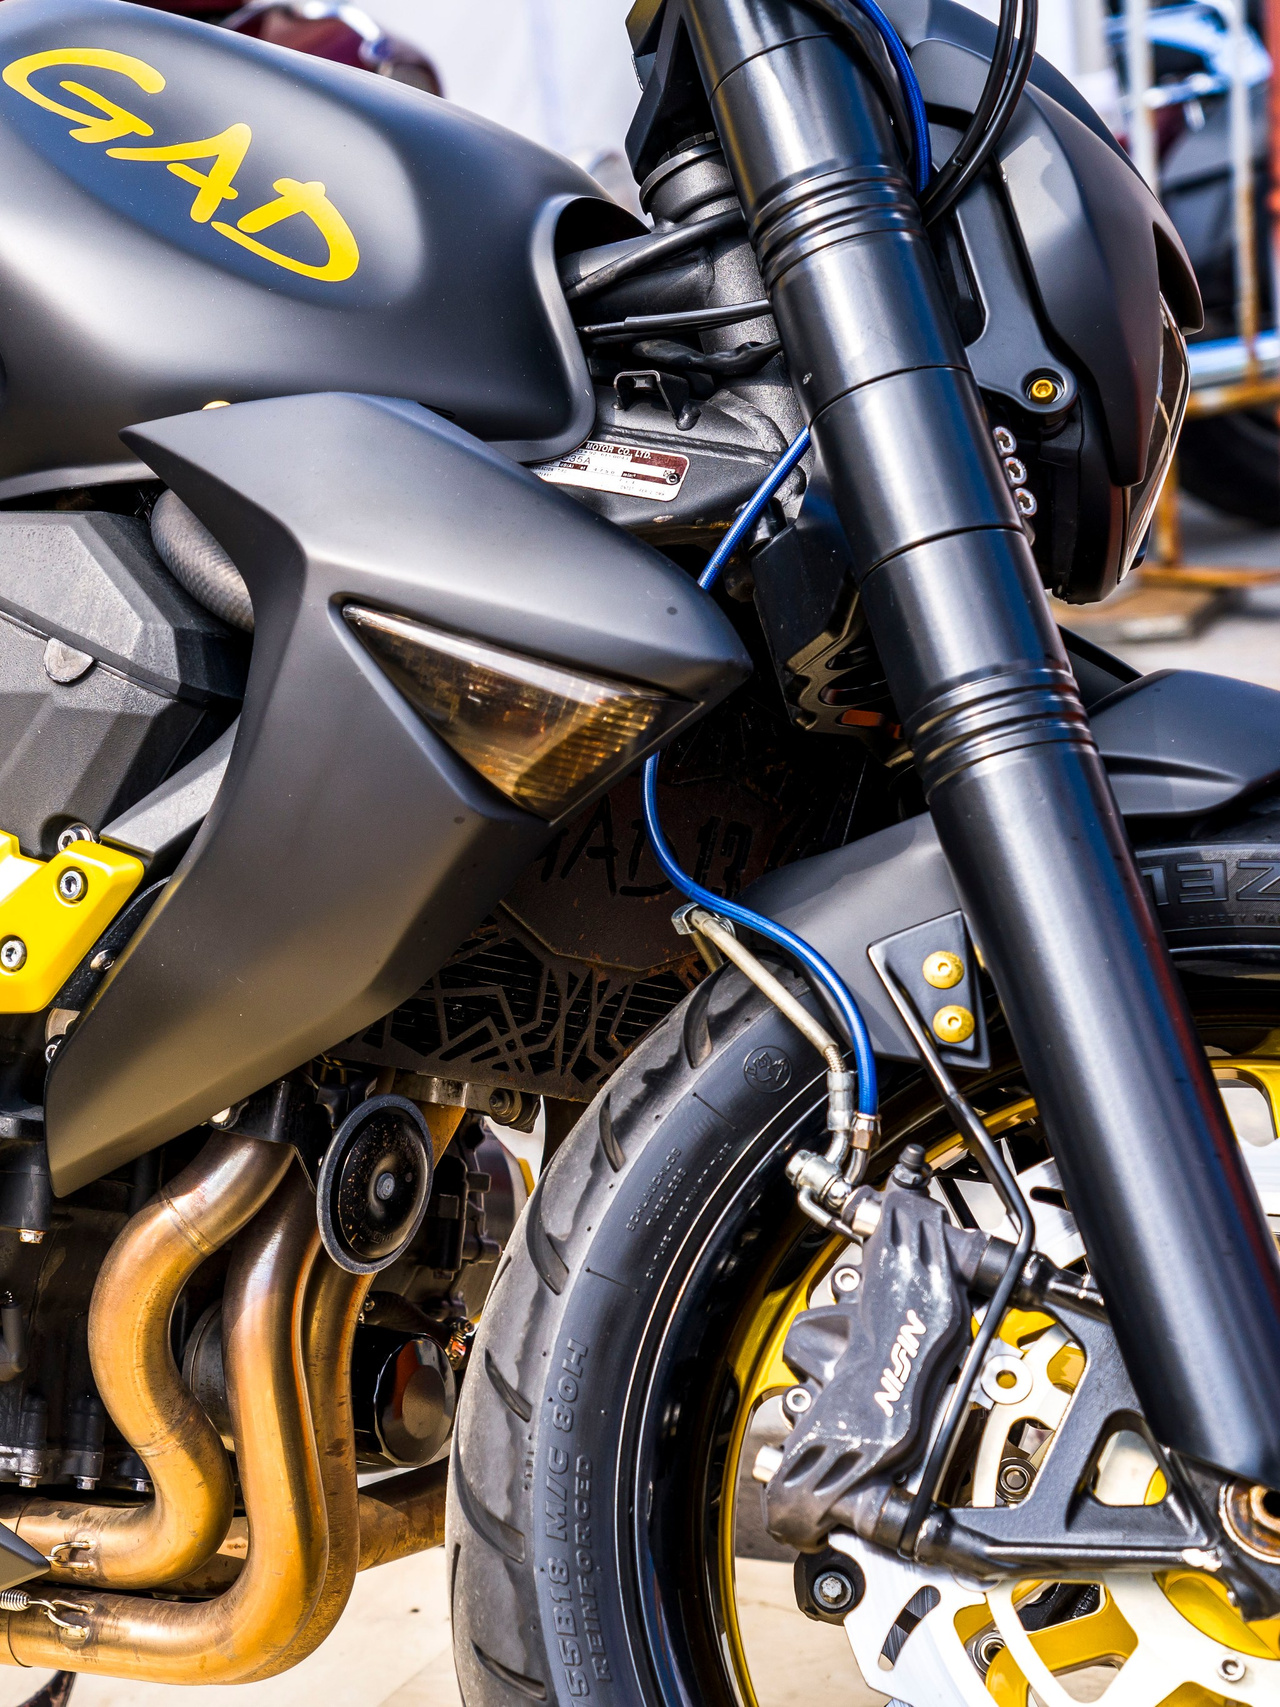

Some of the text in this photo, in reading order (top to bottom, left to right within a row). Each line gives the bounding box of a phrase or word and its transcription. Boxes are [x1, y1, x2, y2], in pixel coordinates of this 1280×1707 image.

[2, 48, 360, 282] GAD
[586, 442, 614, 453] MOTOR
[634, 451, 651, 459] LTD.
[1187, 913, 1280, 926] SAFETY WA
[625, 1147, 682, 1232] SCHLAUCHLOS
[645, 1167, 687, 1227] TUBELESS
[552, 1338, 588, 1433] 80H
[874, 1309, 927, 1418] NISSIN
[545, 1446, 570, 1542] M/C
[573, 1454, 613, 1683] REINFORCED
